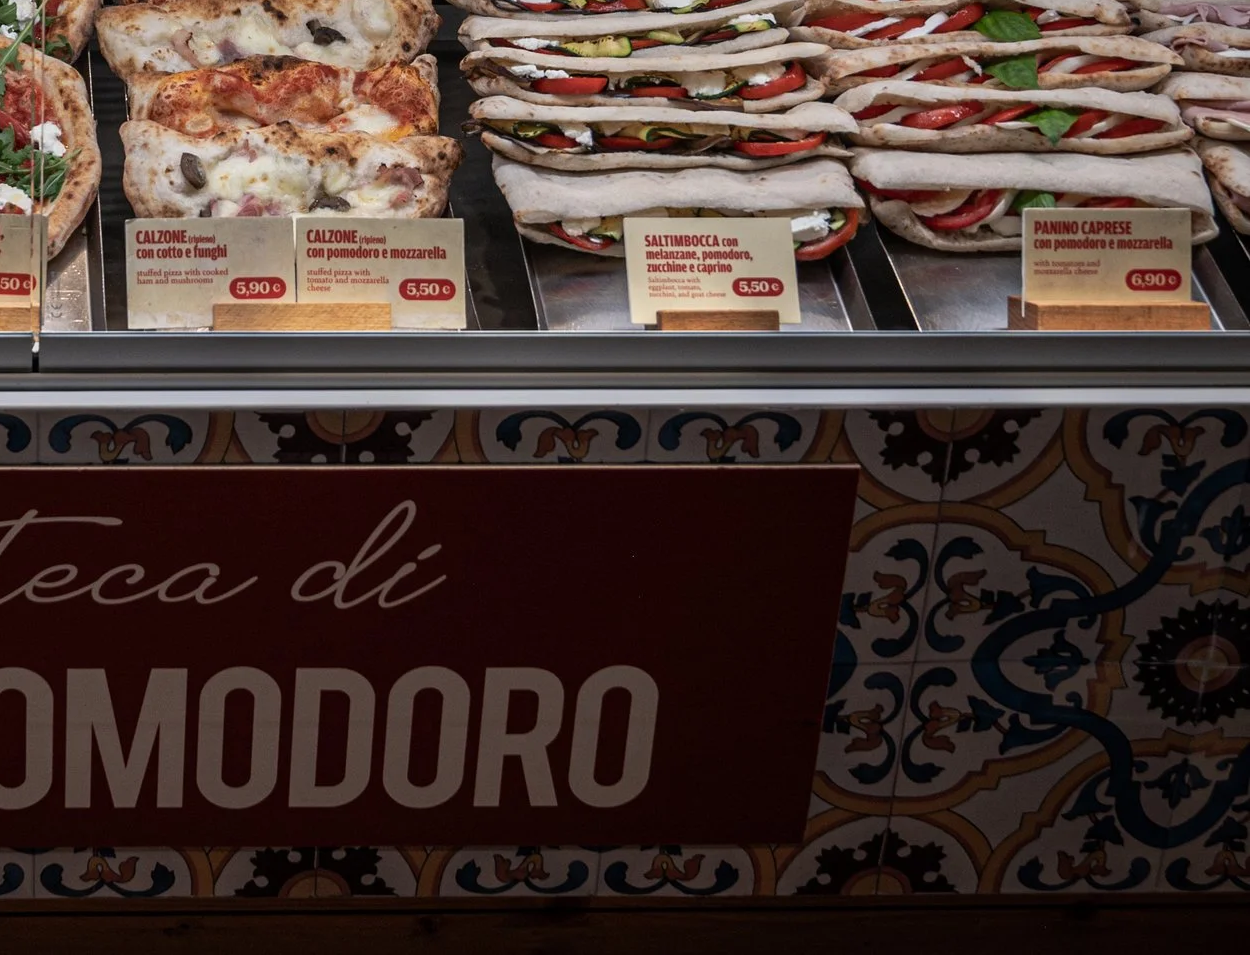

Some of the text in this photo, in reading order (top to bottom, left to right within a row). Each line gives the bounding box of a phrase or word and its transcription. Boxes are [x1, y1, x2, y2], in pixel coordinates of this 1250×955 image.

[1034, 221, 1132, 234] PANINO CAPRESE
[136, 230, 215, 244] CALZONE (ripieno)
[307, 230, 386, 244] CALZONE (ripieno)
[645, 235, 738, 247] SALTIMBOCCA con
[1034, 237, 1173, 251] con pomodoro e mozzarella
[136, 244, 227, 260] con cotto e funghi
[307, 247, 446, 261] con pomodoro e mozzarella
[646, 249, 753, 261] melanzane, pomodoro,
[137, 268, 162, 276] stuffed
[164, 270, 182, 278] pizza
[307, 268, 332, 276] stuffed
[334, 269, 352, 277] pizza
[647, 261, 732, 275] zucchine e caprino
[289, 499, 449, 608] di
